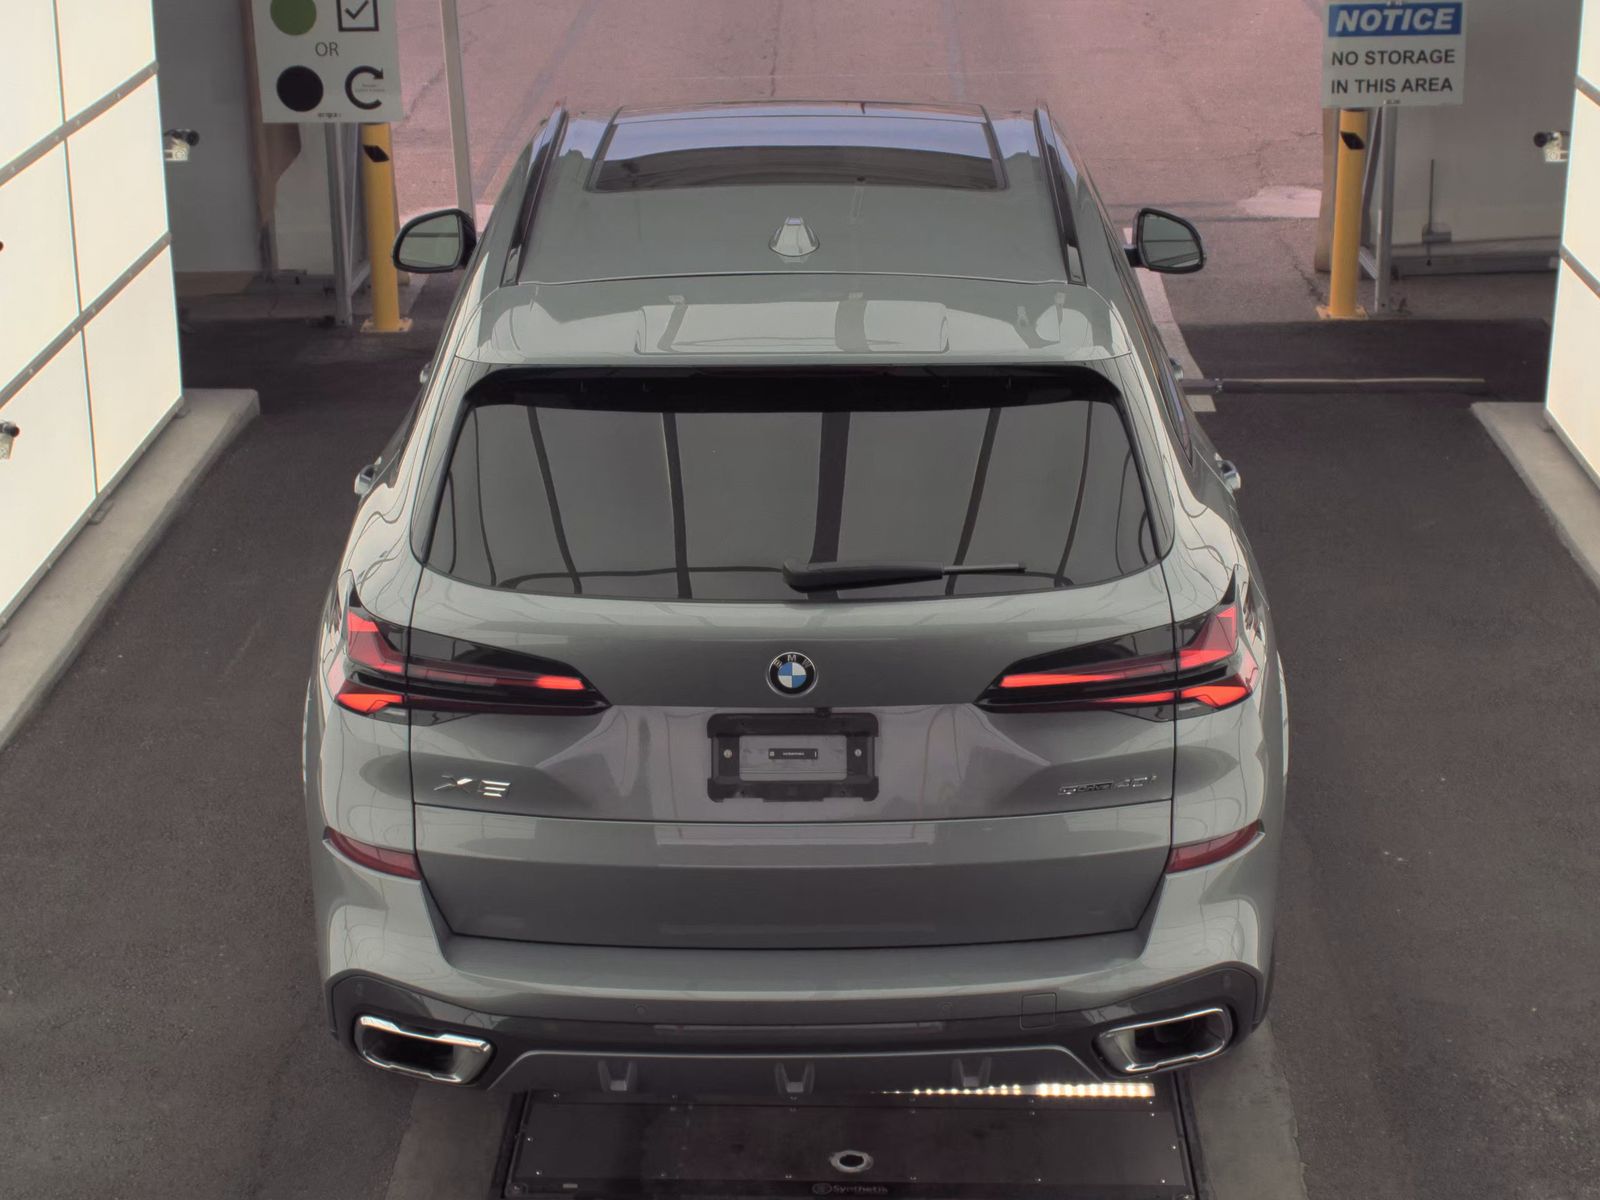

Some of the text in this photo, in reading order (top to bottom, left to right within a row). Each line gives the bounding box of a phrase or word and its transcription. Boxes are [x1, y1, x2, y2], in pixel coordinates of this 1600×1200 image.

[1335, 7, 1455, 32] NOTICE
[315, 41, 339, 57] OR
[1331, 49, 1455, 66] NO STORAGE
[1331, 77, 1453, 94] IN THIS AREA
